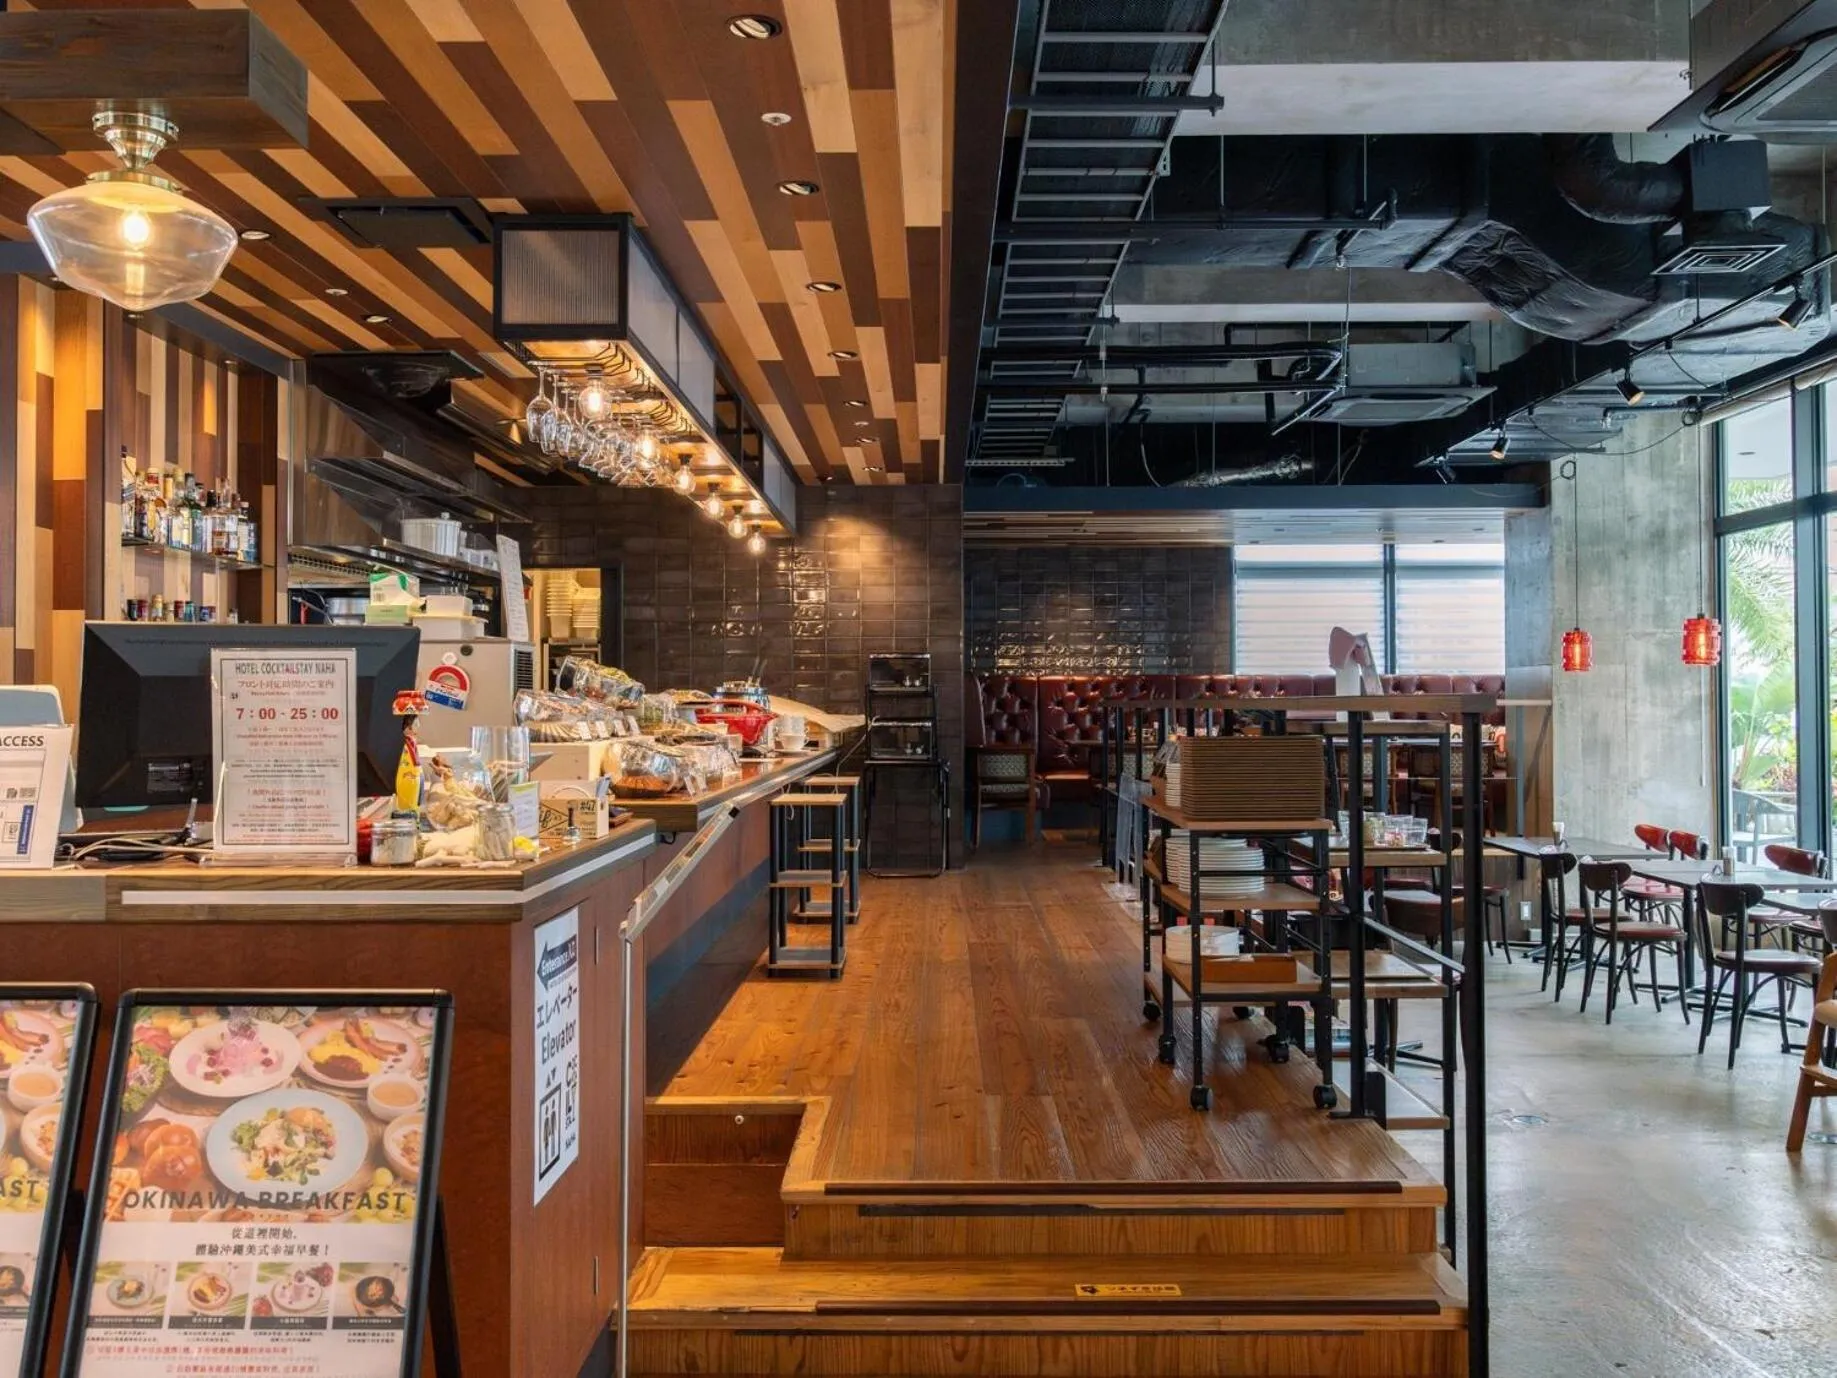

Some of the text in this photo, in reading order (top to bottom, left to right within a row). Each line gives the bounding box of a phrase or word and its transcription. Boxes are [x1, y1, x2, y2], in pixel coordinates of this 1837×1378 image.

[235, 662, 336, 674] HOTEL COCKTAILSTAY NAHA
[0, 735, 44, 747] CCESS
[537, 986, 578, 1029] エレベーター
[541, 1019, 577, 1065] Elevator
[123, 1190, 406, 1210] OKINAWA BREAKFAST
